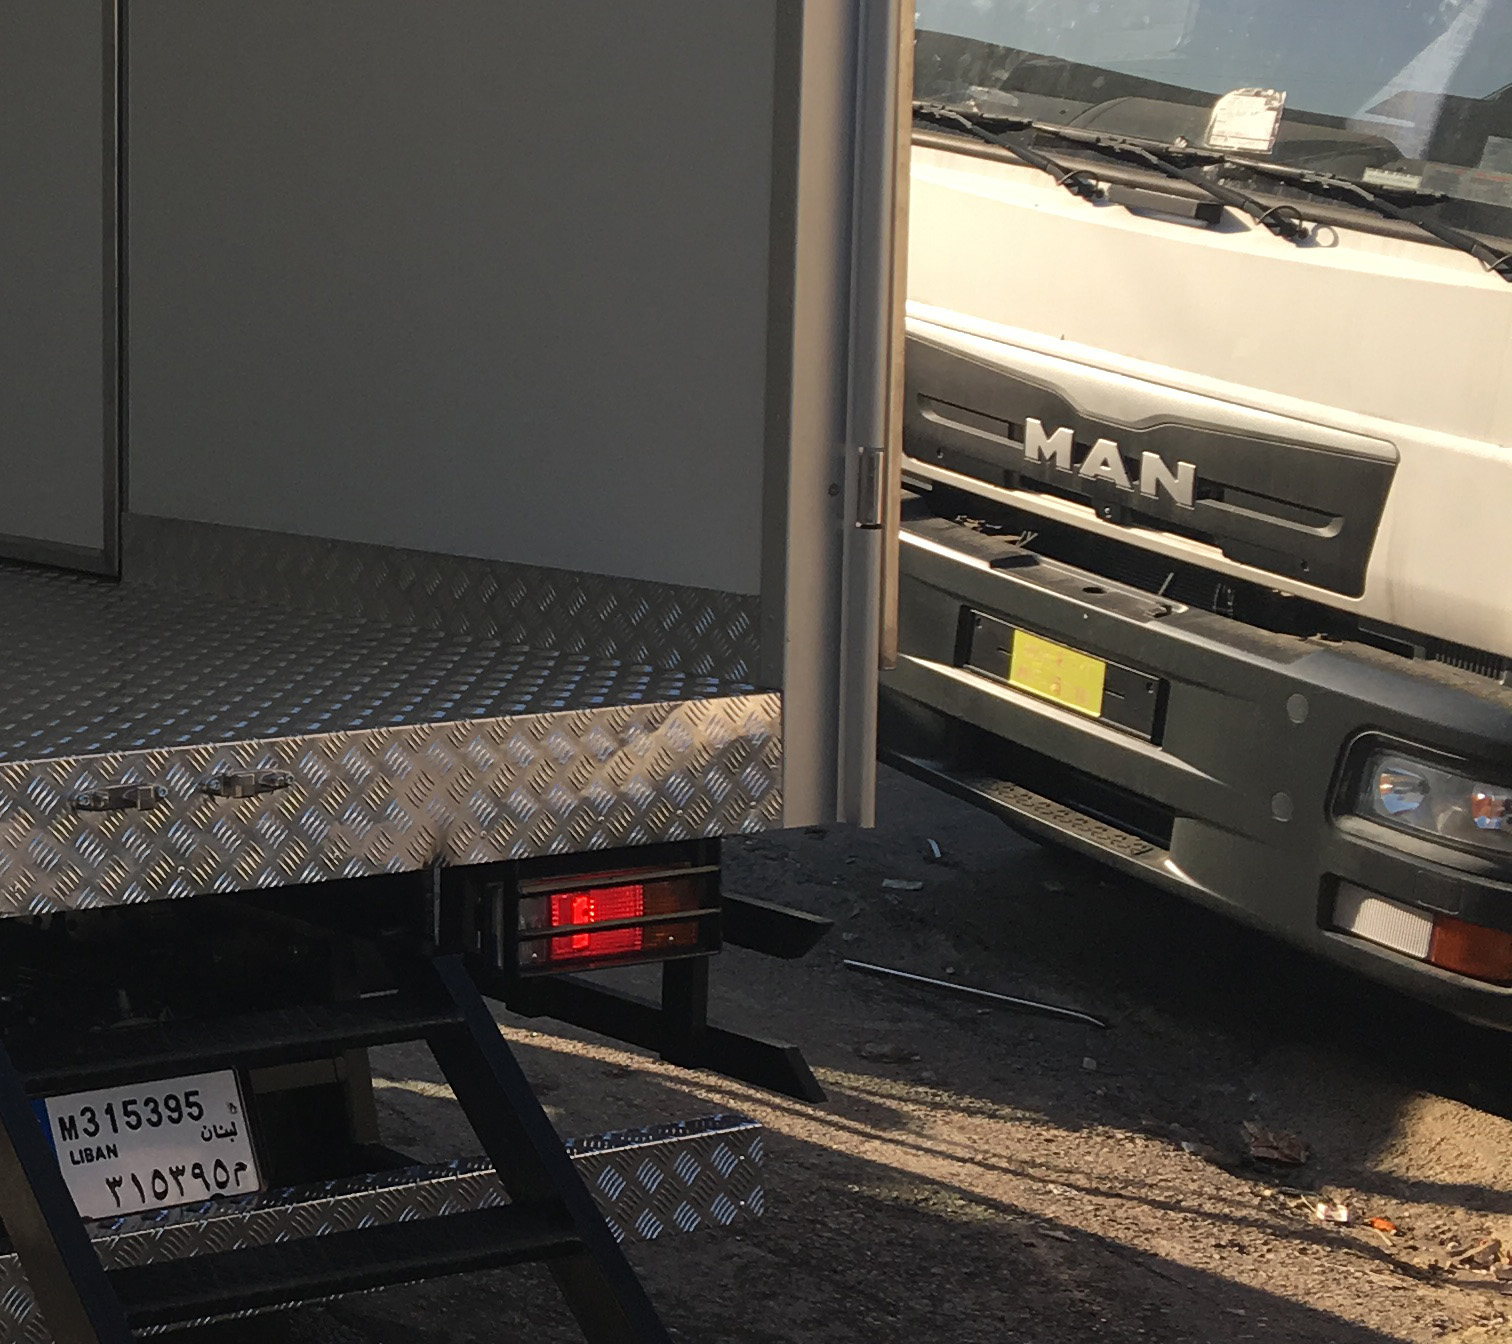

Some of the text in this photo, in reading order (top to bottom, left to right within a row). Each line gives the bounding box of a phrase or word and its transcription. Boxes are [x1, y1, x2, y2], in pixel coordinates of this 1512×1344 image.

[1024, 417, 1196, 510] MAN
[58, 1090, 204, 1142] M315395
[201, 1120, 238, 1143] لبنان
[69, 1144, 119, 1167] LIBAN
